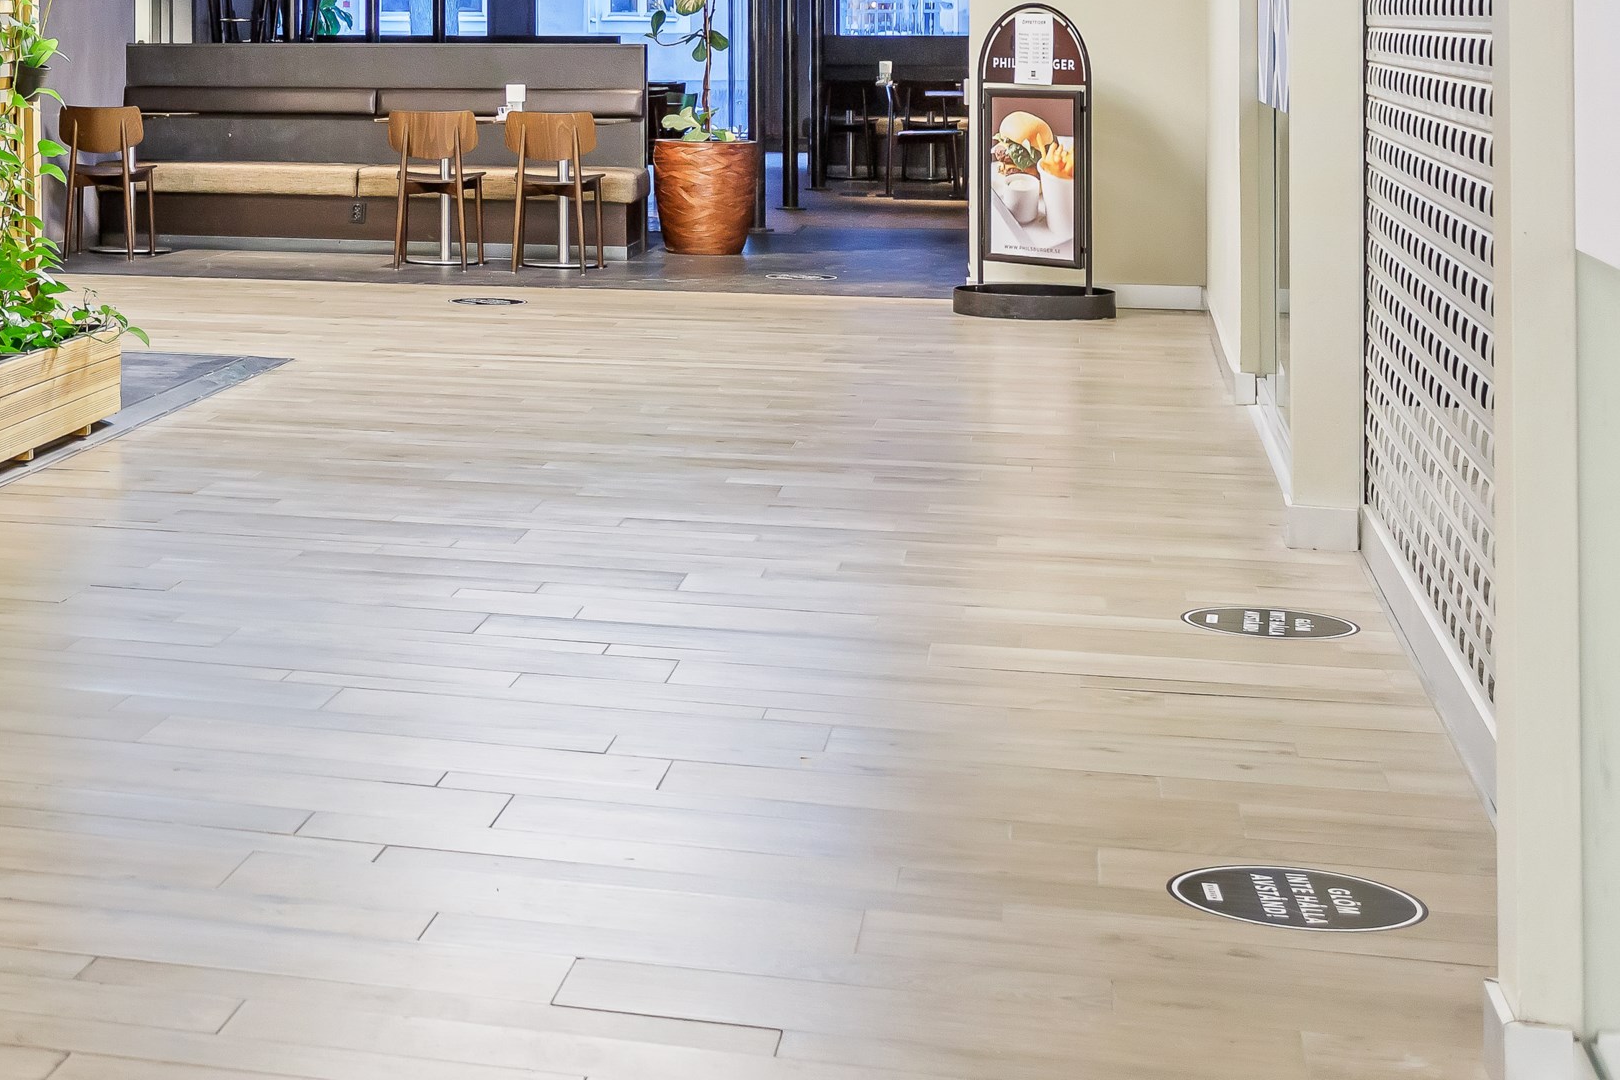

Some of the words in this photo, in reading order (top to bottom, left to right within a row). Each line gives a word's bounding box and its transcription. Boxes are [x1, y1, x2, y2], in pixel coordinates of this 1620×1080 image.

[992, 57, 1016, 69] PHIL
[1053, 59, 1075, 71] GER
[1249, 873, 1289, 919] AVSTÅND!
[1285, 873, 1314, 895] INTE
[1298, 894, 1329, 924] HÅLLA
[1327, 887, 1361, 915] GLÖM
